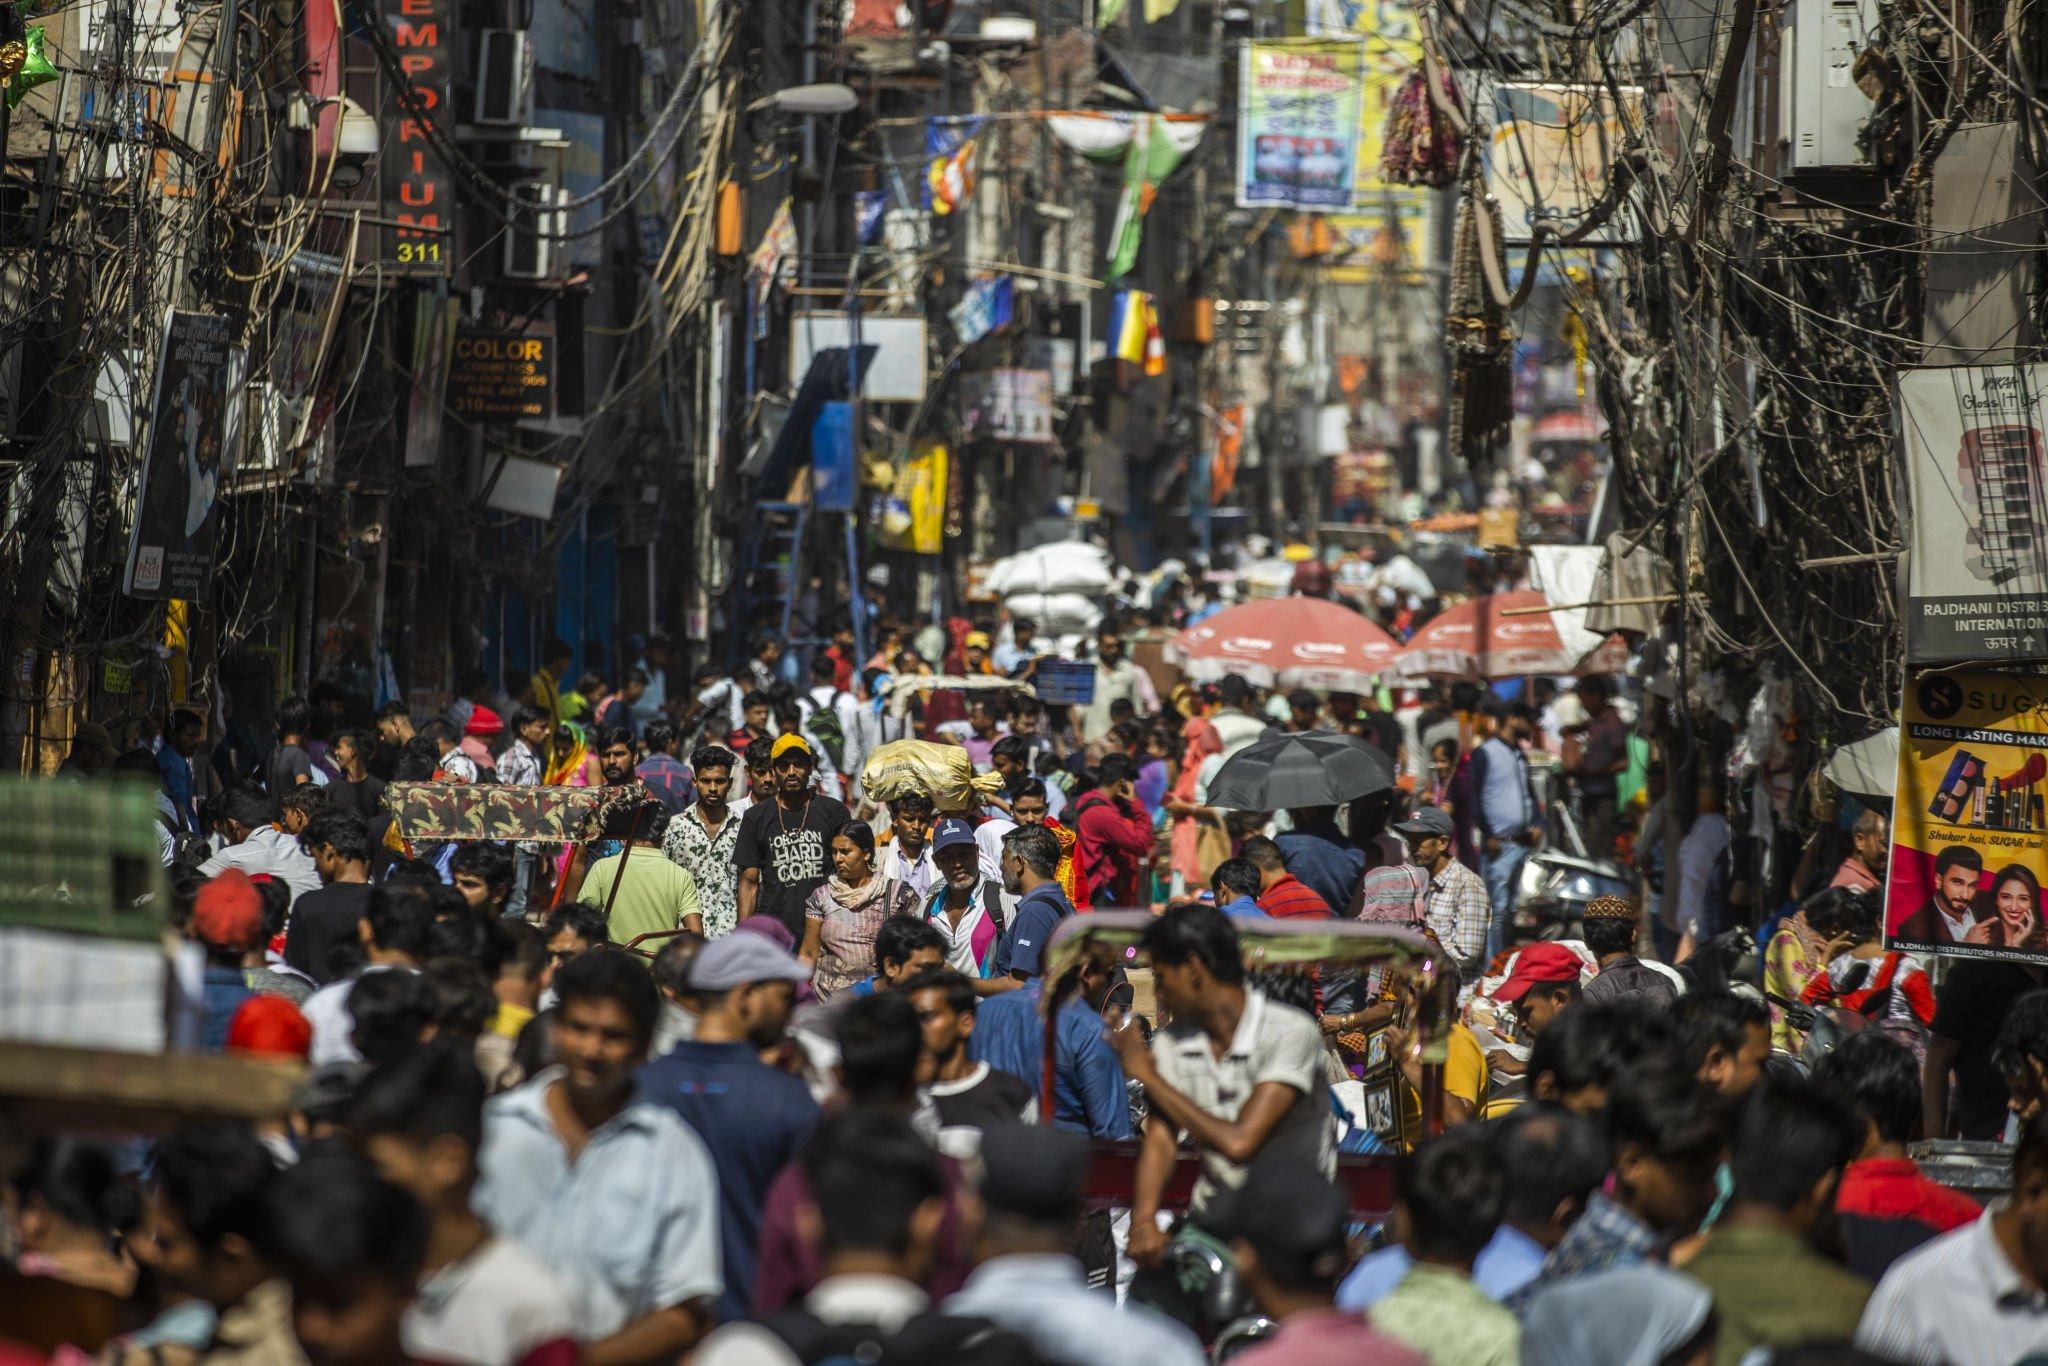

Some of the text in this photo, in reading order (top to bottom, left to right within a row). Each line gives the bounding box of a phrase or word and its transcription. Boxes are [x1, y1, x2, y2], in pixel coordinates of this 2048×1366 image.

[397, 243, 439, 263] 311
[456, 338, 543, 361] COLOR
[456, 397, 484, 412] 310
[1962, 394, 1999, 409] Gloss
[2003, 392, 2017, 407] It
[1924, 602, 1992, 615] RAJDHANI
[1955, 617, 2048, 632] INTERNATION
[1984, 637, 2018, 649] ऊपर
[1913, 725, 2048, 746] LONG LASTING MAK
[1928, 830, 2043, 848] Shukar hai, SUGAR hai
[775, 842, 824, 862] HARD
[777, 861, 824, 882] CORE
[1893, 941, 1935, 951] RAJDHANI
[1937, 945, 1994, 957] DISTRIBUTORS
